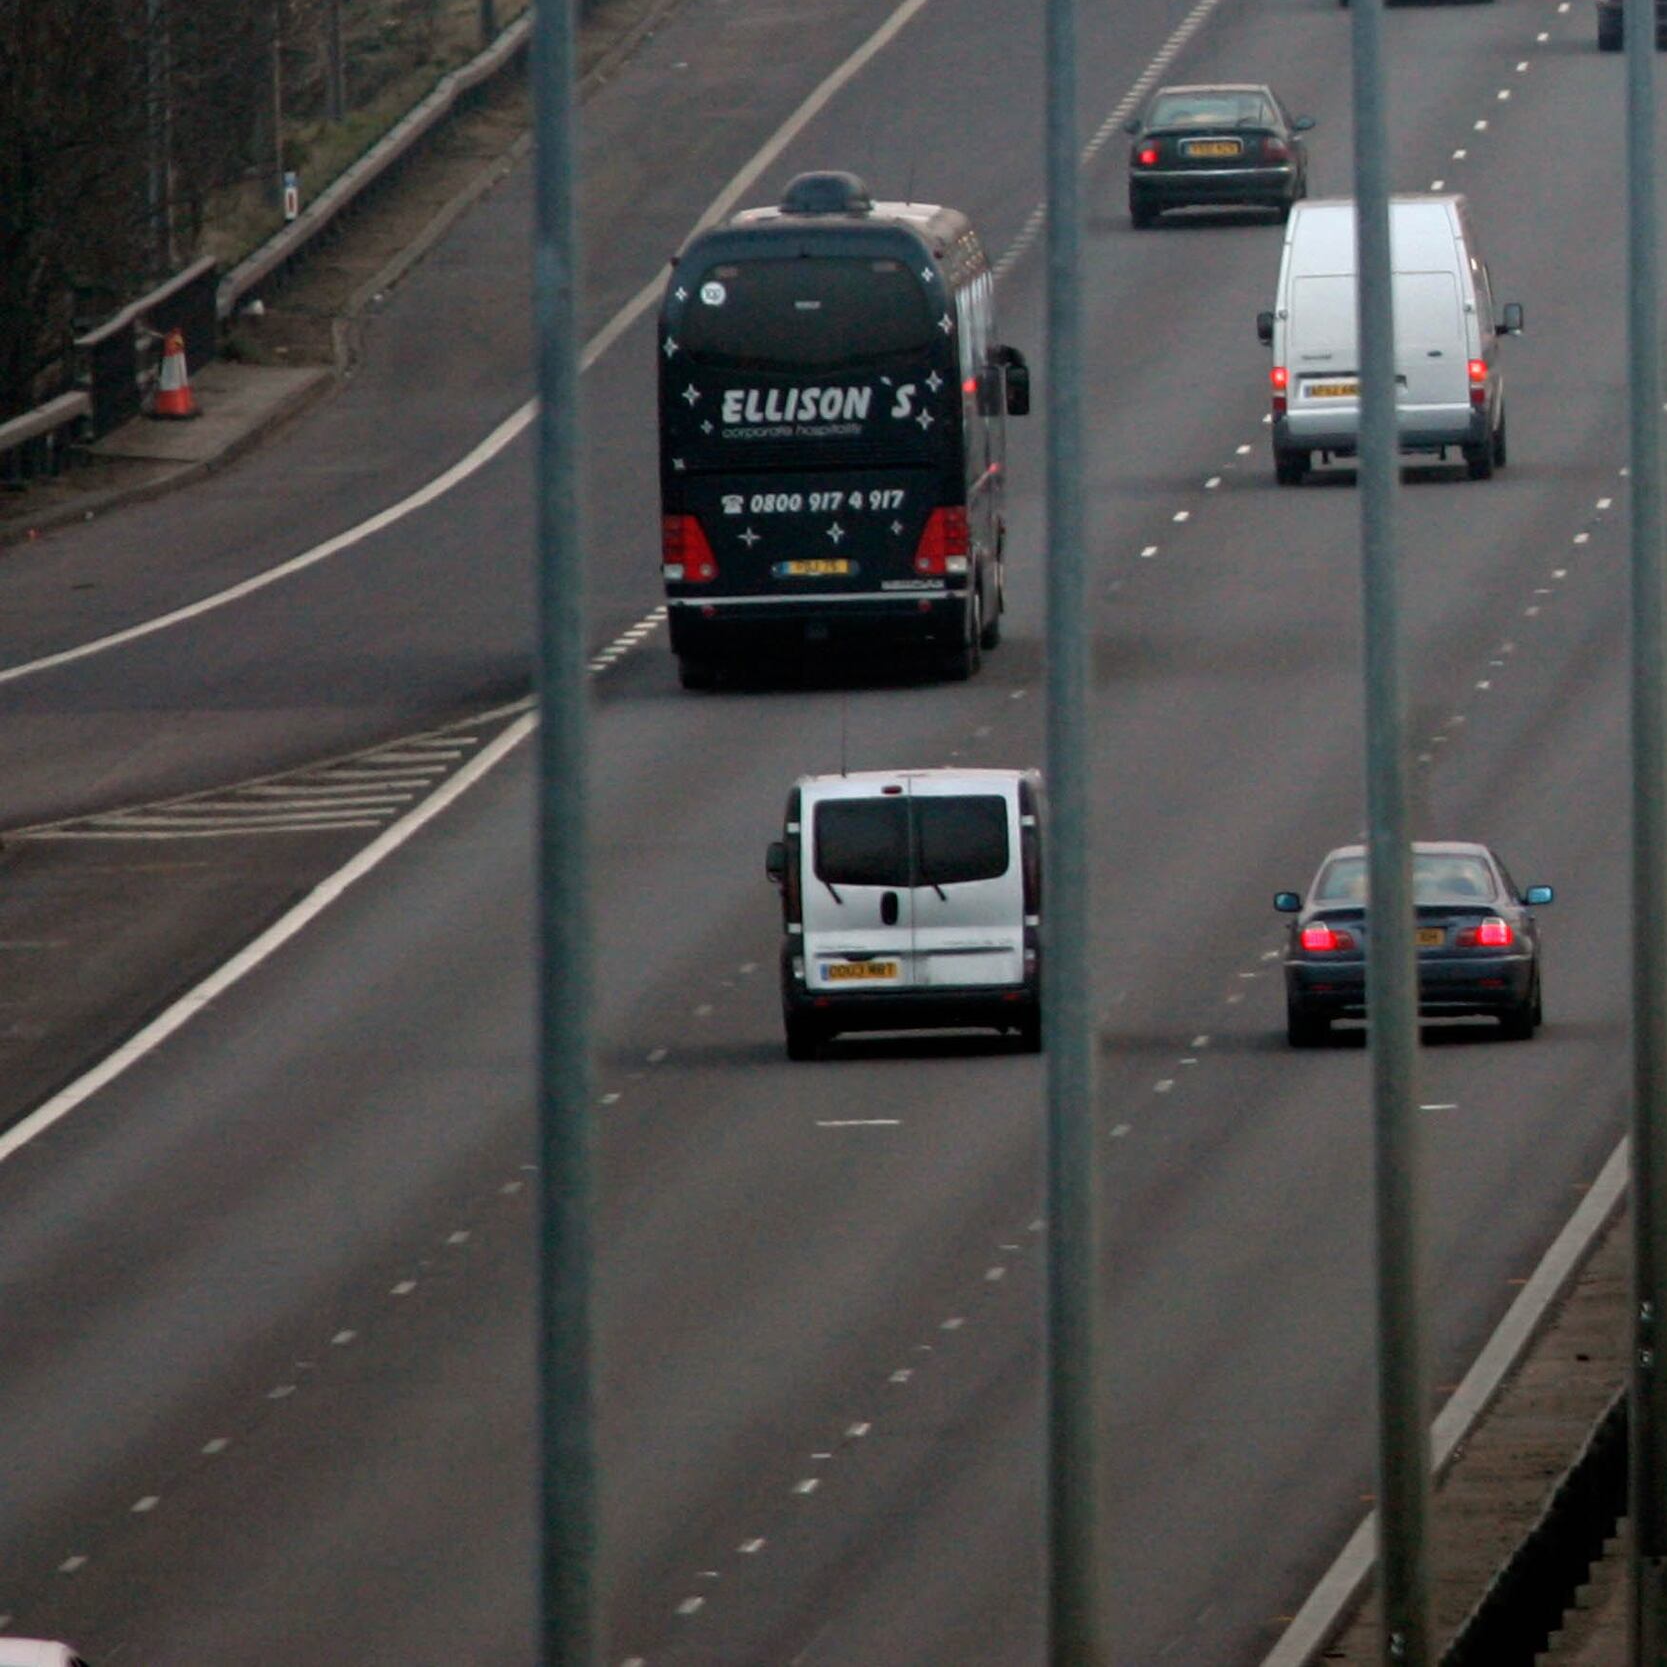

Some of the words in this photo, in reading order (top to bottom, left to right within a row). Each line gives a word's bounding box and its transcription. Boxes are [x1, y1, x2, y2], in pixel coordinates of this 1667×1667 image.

[750, 493, 802, 514] 0800
[808, 491, 843, 511] 917
[869, 489, 905, 509] 917
